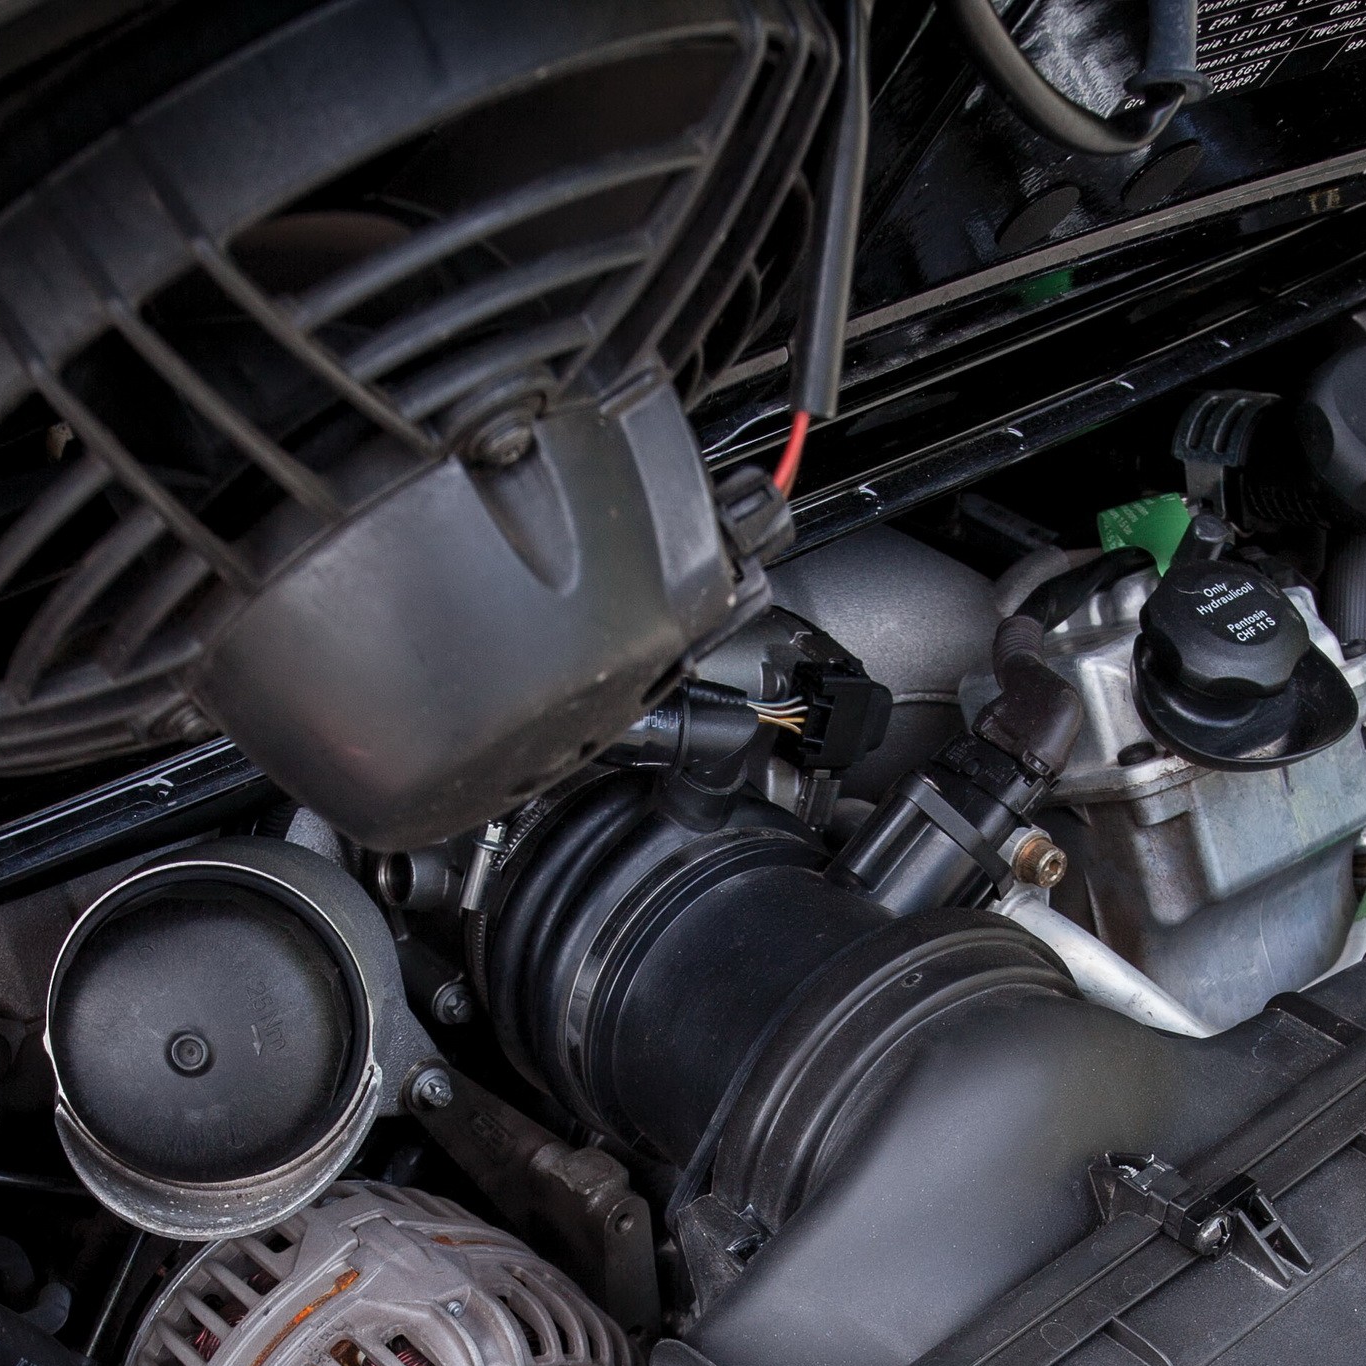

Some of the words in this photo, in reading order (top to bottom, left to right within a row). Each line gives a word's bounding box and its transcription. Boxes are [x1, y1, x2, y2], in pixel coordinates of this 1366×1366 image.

[1208, 14, 1242, 31] EPA:
[1251, 1, 1288, 19] T2B5
[1229, 27, 1259, 43] LEV
[1276, 16, 1299, 31] PC
[1329, 0, 1358, 16] OBD:
[1241, 37, 1291, 59] needed.
[1196, 581, 1255, 616] Hydraulicoil
[1203, 582, 1228, 598] Only
[1227, 608, 1268, 634] Pentosin
[1236, 625, 1257, 642] CHF
[1255, 619, 1267, 632] 11
[1265, 616, 1276, 626] S
